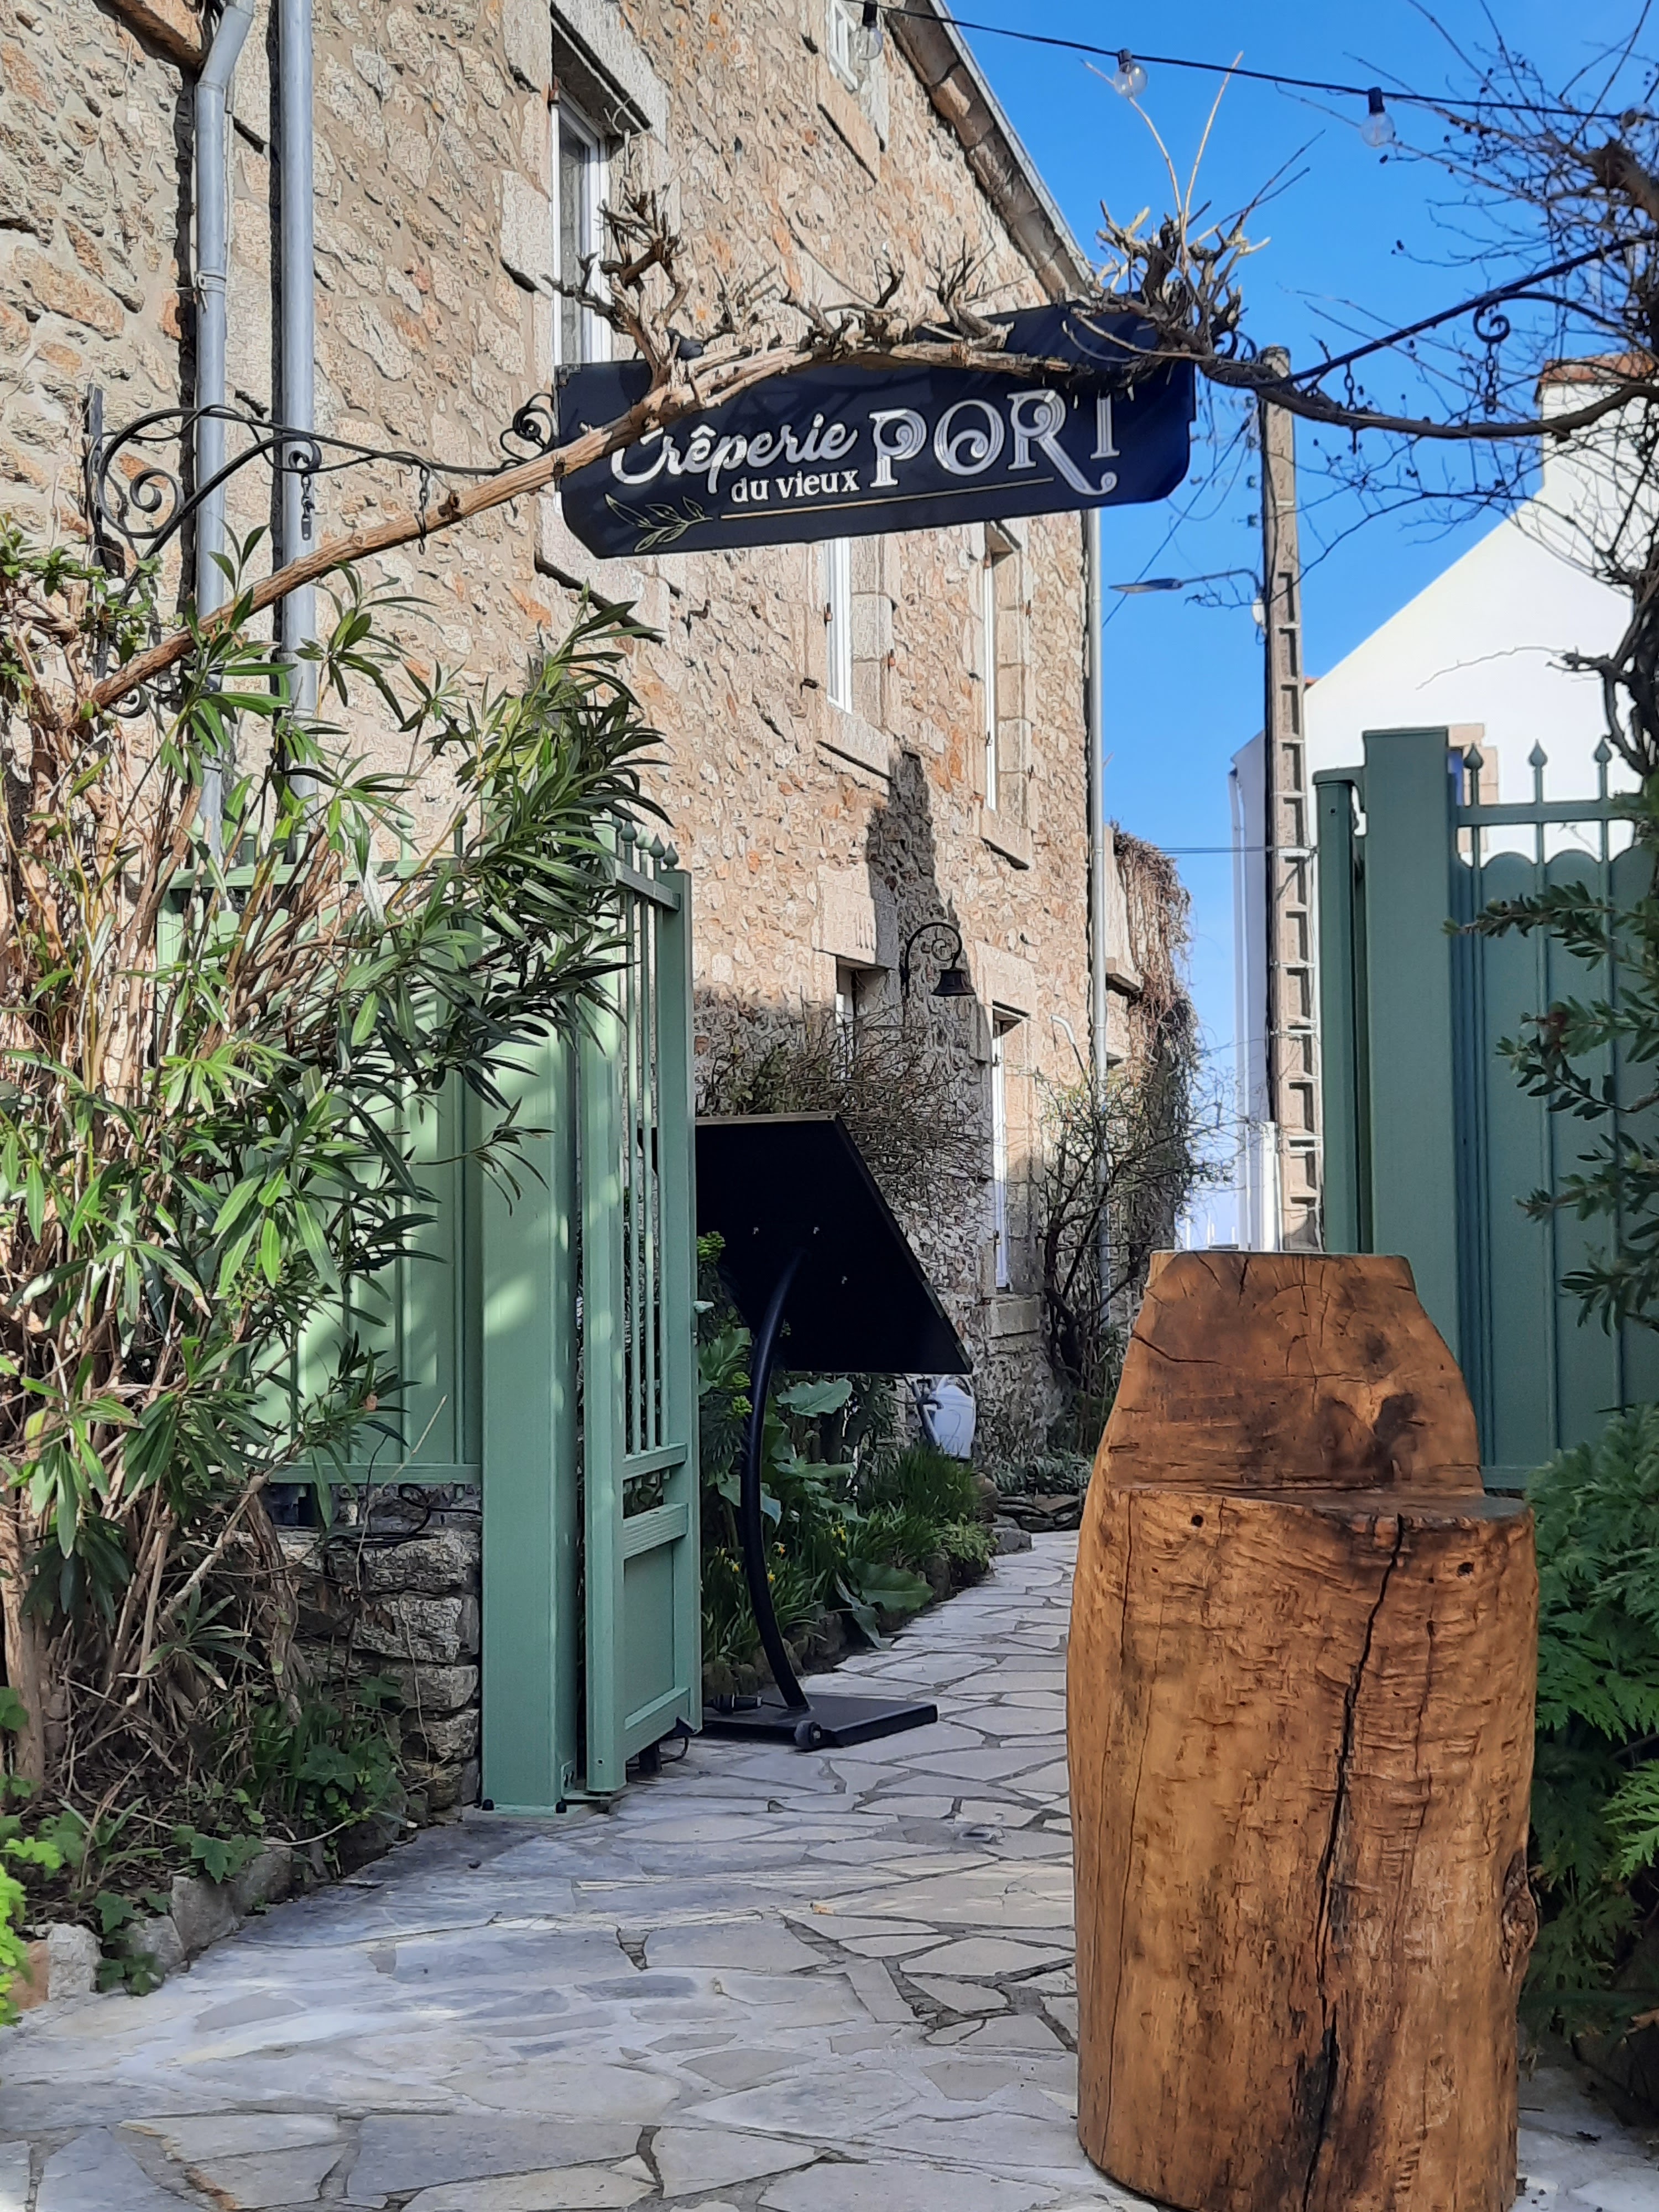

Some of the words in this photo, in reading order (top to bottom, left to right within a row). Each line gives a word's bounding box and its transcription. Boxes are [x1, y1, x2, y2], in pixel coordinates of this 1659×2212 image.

[611, 413, 857, 494] Crêperie
[731, 477, 769, 503] du
[776, 468, 860, 498] vieux
